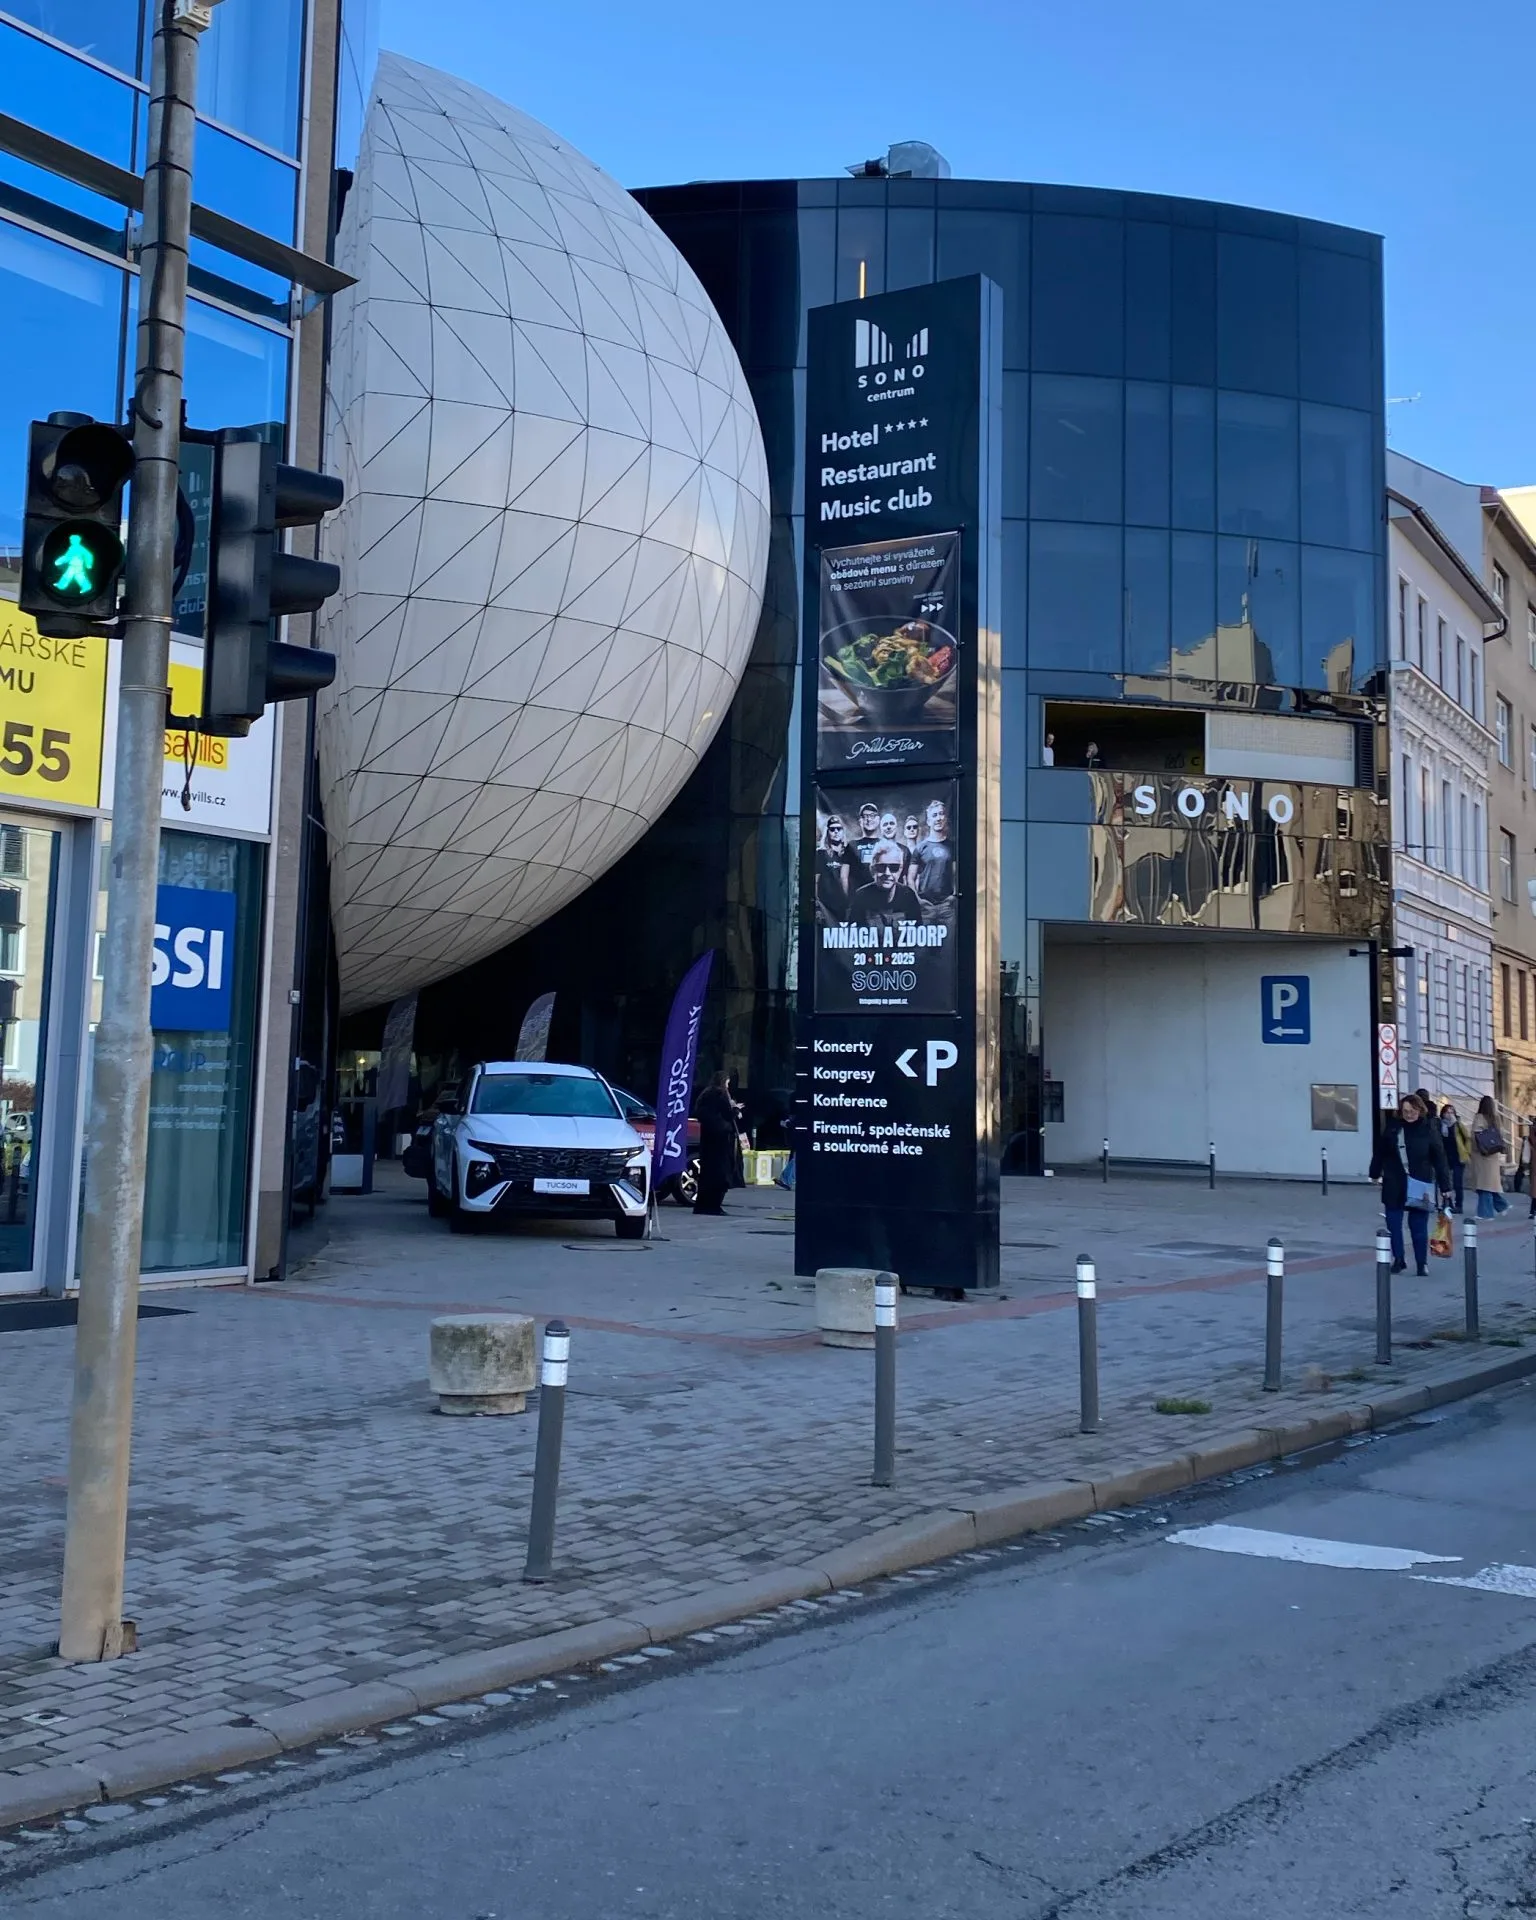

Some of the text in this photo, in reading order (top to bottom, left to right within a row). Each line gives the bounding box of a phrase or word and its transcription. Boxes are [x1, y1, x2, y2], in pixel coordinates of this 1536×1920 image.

[857, 364, 925, 388] SONO
[867, 386, 915, 402] centrum
[821, 423, 879, 453] Hotel
[821, 452, 937, 487] Restaurant
[820, 485, 933, 521] Music club
[830, 567, 870, 580] obědové
[870, 564, 897, 576] menu
[898, 564, 905, 572] s
[831, 554, 882, 569] Vychutnejte
[830, 582, 842, 592] na
[878, 574, 915, 586] suroviny
[0, 623, 86, 668] ÁŘSKÉ
[0, 720, 71, 783] 55
[1134, 785, 1294, 824] SONO
[823, 919, 948, 949] MŇÁGA A ŽĎORP
[851, 969, 917, 991] SONO
[1271, 983, 1299, 1020] P
[813, 1039, 873, 1056] Koncerty
[813, 1066, 876, 1083] Kongresy
[926, 1040, 959, 1087] P
[813, 1093, 888, 1108] Konference
[812, 1120, 951, 1139] Firemní, společenské
[812, 1139, 923, 1156] a soukromé akce
